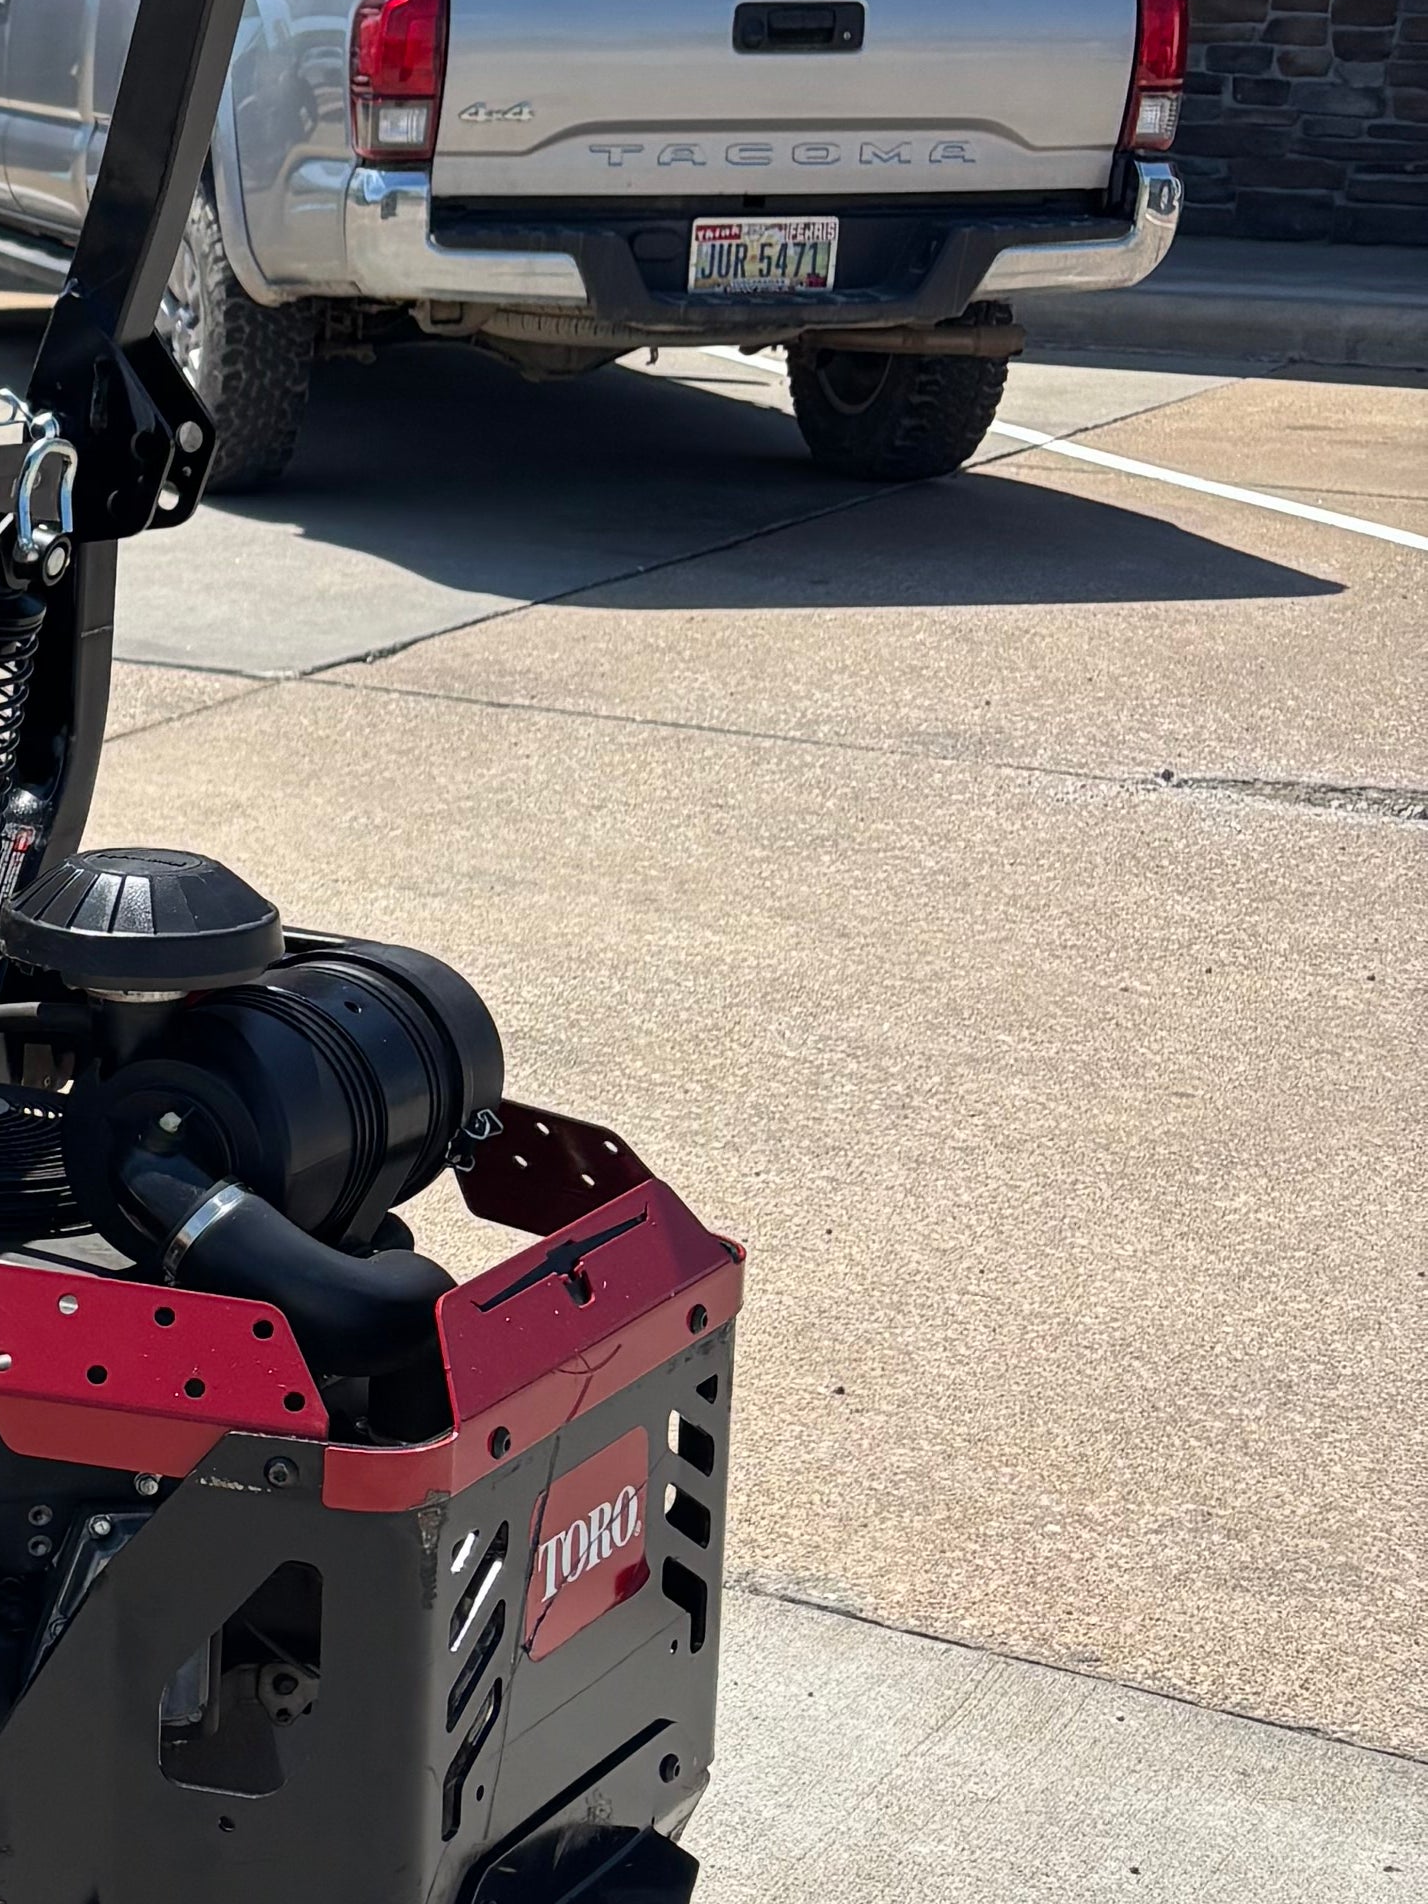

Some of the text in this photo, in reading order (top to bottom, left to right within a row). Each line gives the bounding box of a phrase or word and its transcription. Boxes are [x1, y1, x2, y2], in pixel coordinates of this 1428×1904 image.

[588, 139, 977, 168] TACOMA
[700, 242, 819, 279] JUR 5471
[537, 1484, 638, 1603] TORO
